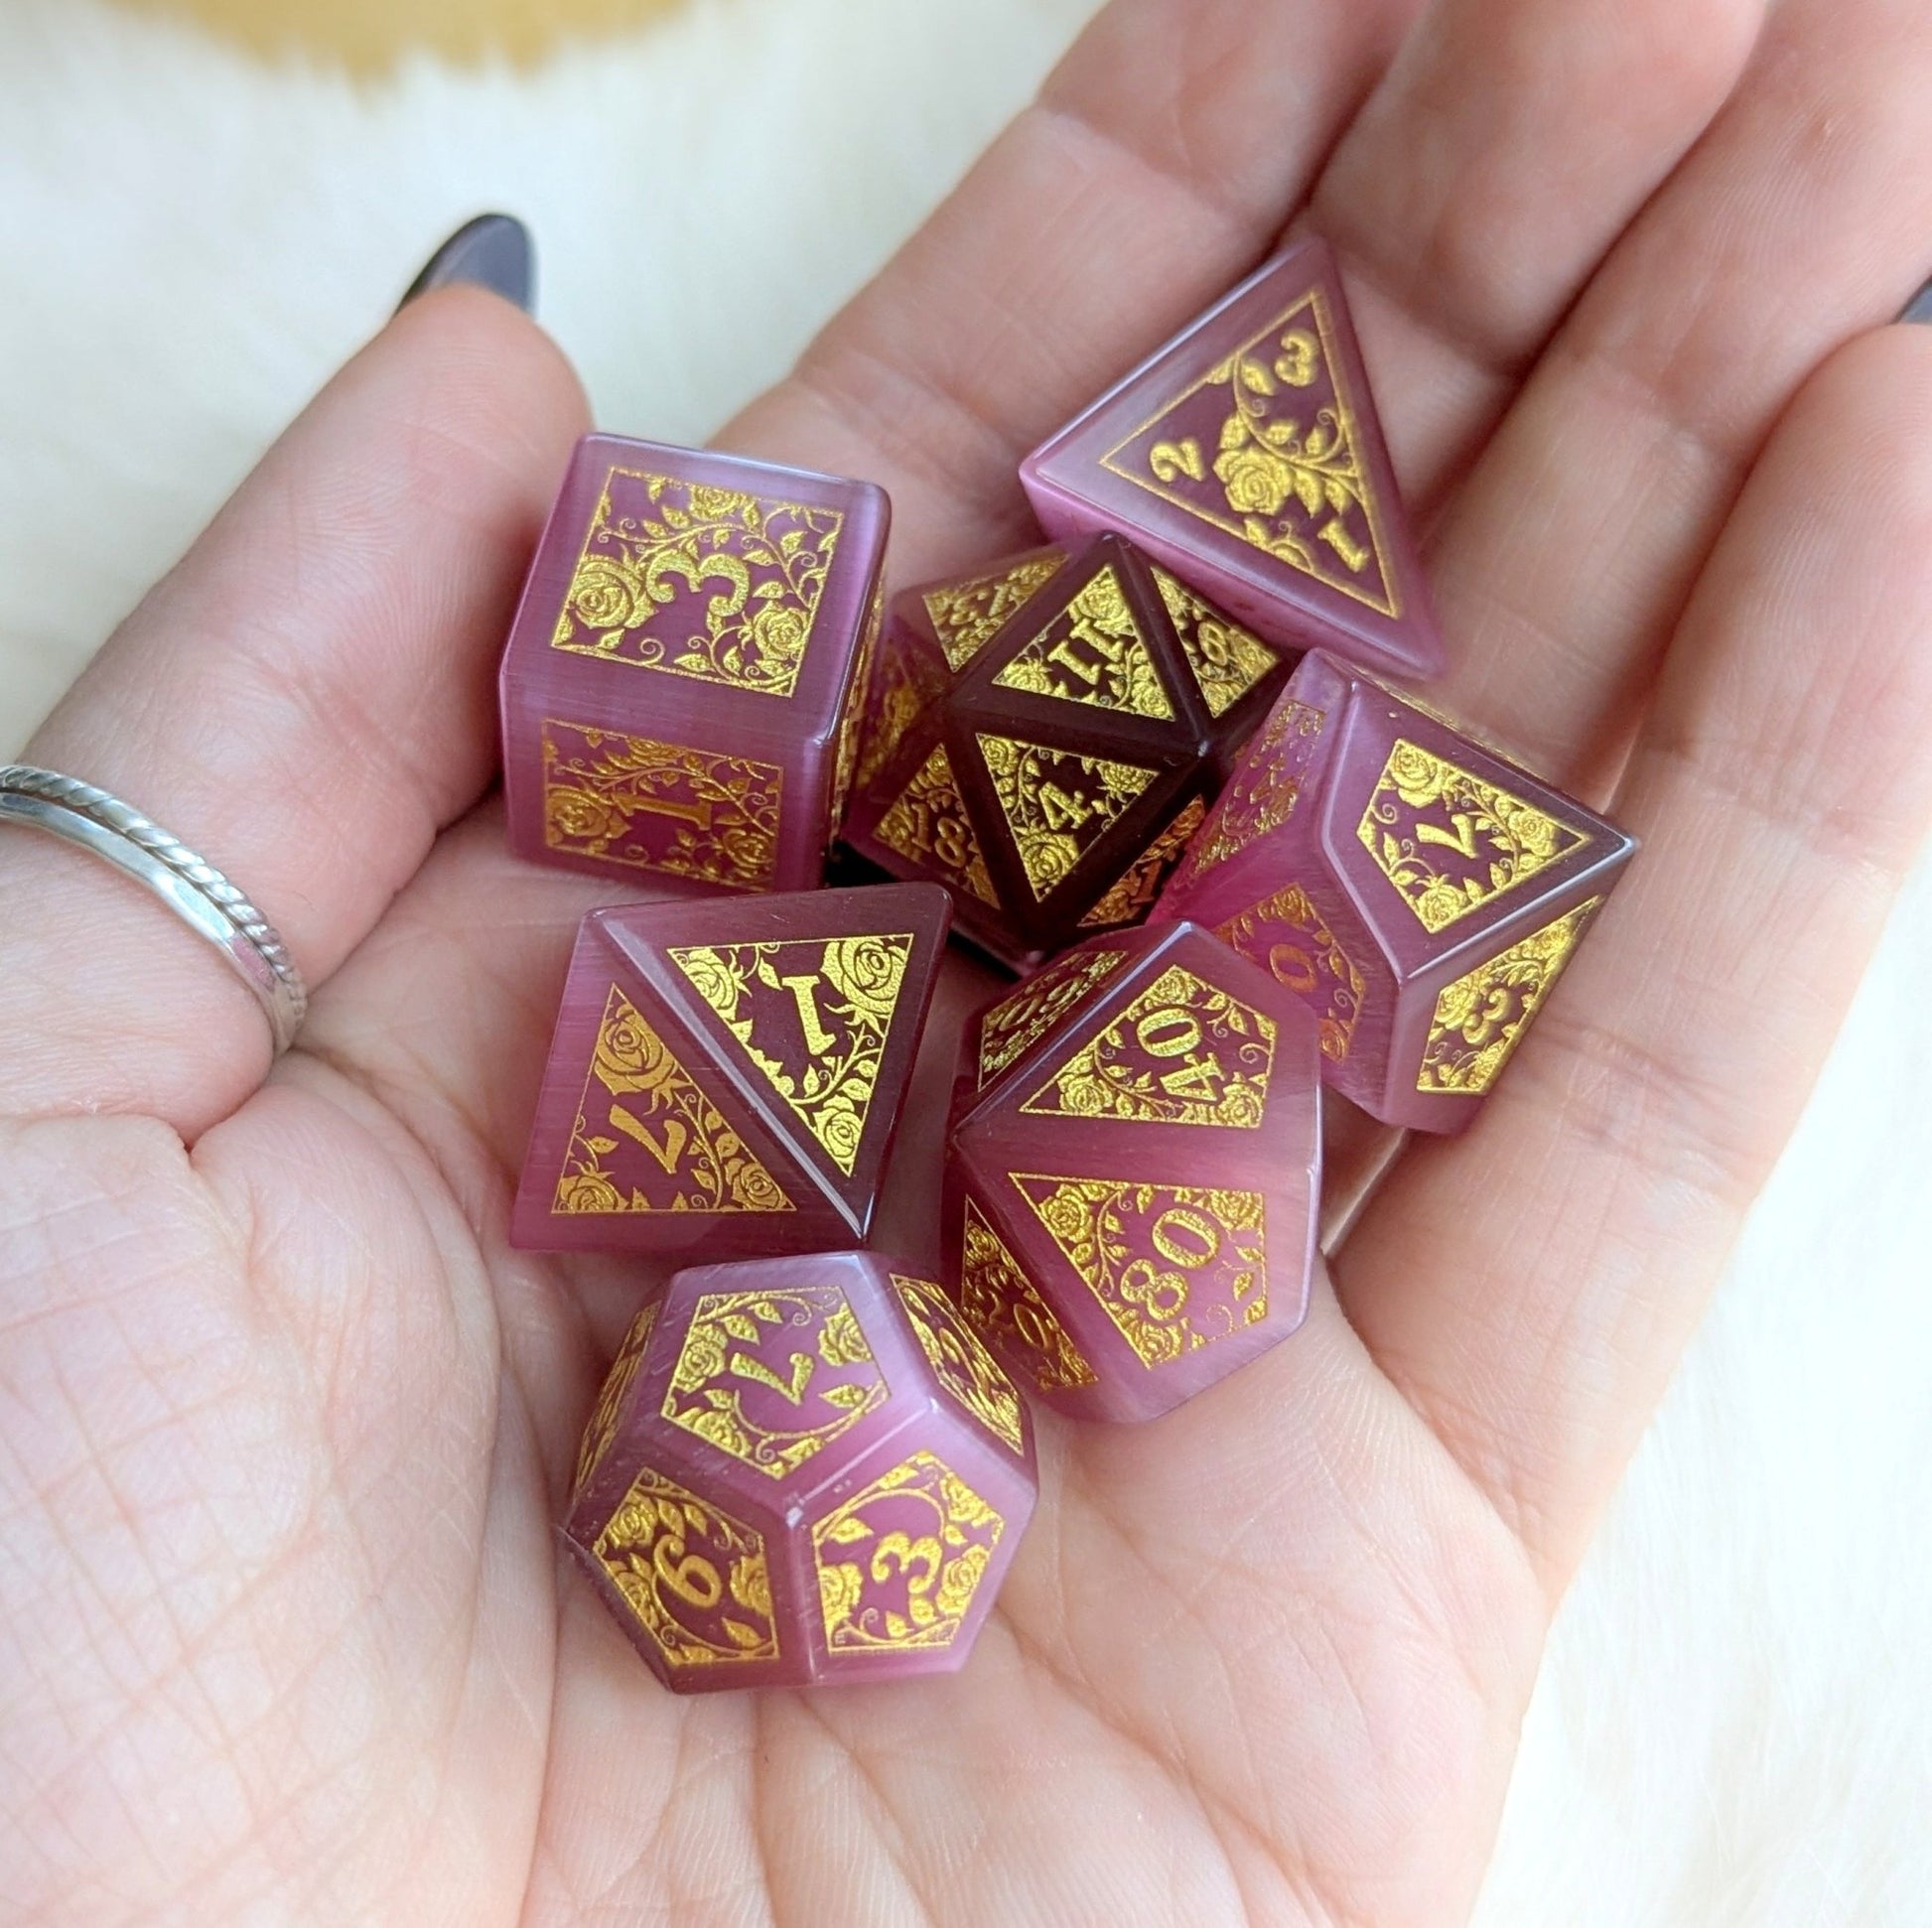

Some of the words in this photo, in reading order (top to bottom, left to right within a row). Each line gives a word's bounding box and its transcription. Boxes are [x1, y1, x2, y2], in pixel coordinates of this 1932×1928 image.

[1275, 329, 1318, 387] 3
[1150, 437, 1204, 482] 2
[1317, 518, 1369, 572] 1
[646, 550, 750, 618] 3
[1048, 619, 1123, 685] 11
[613, 792, 712, 830] 1
[1038, 781, 1093, 830] 4
[911, 802, 966, 868] 18
[1415, 815, 1477, 859] 7
[1269, 943, 1317, 991] 0
[782, 975, 836, 1056] 1
[1460, 988, 1512, 1044] 3
[1135, 1008, 1227, 1103] 40
[609, 1104, 686, 1173] 7
[1120, 1208, 1220, 1321] 80
[730, 1351, 814, 1406] 7
[871, 1532, 943, 1594] 3
